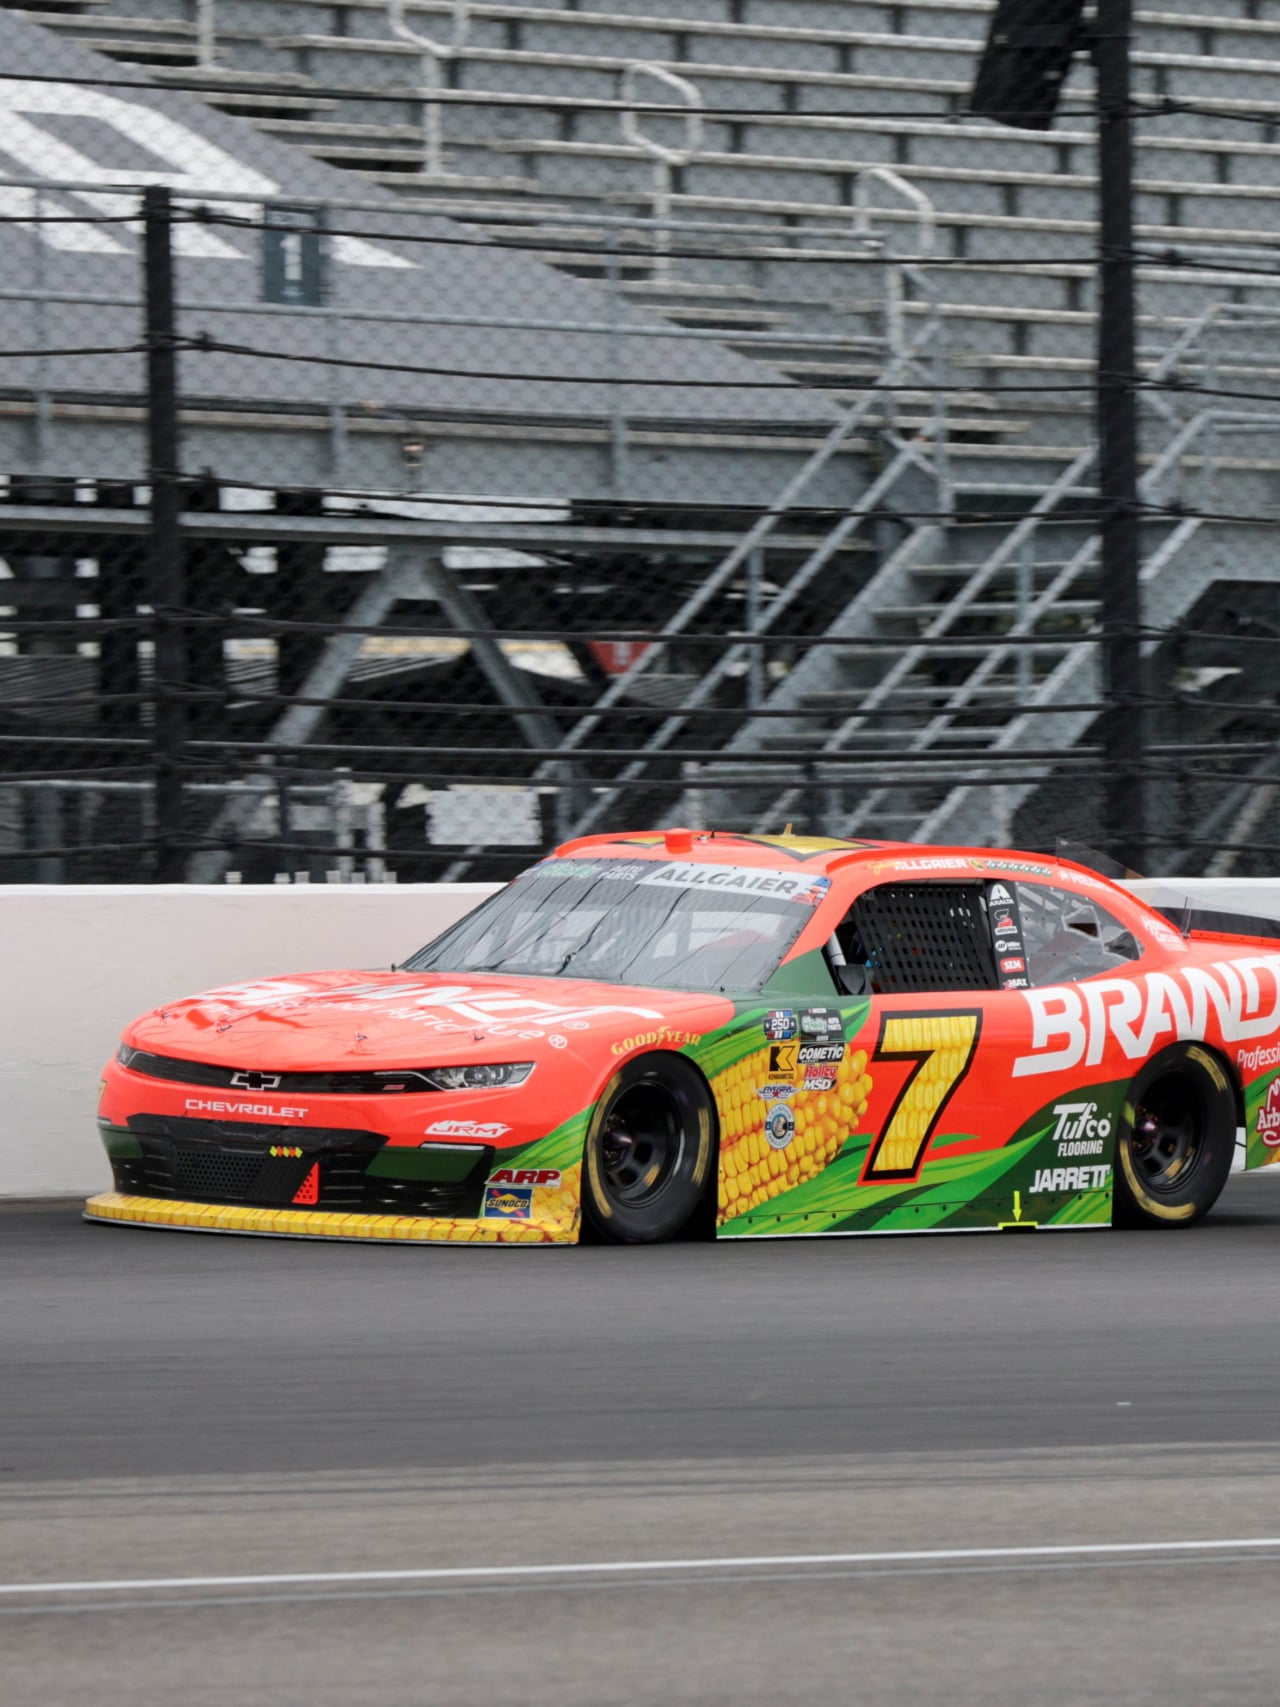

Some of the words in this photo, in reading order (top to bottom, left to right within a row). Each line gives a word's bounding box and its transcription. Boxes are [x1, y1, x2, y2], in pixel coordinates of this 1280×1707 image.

[653, 868, 798, 895] ALLGAIER
[771, 1019, 790, 1031] 250
[611, 1026, 701, 1055] GOODYEAR
[799, 1046, 844, 1060] COMETIC
[802, 1079, 833, 1091] MSD
[864, 1008, 983, 1180] 7
[185, 1098, 309, 1119] CHEVROLET
[432, 1125, 498, 1136] JRM
[1052, 1103, 1111, 1141] Tufco
[1057, 1140, 1103, 1157] FLOORING
[490, 1169, 561, 1184] ARP
[1029, 1165, 1111, 1193] JARRETT
[486, 1198, 529, 1209] SUNOCO
